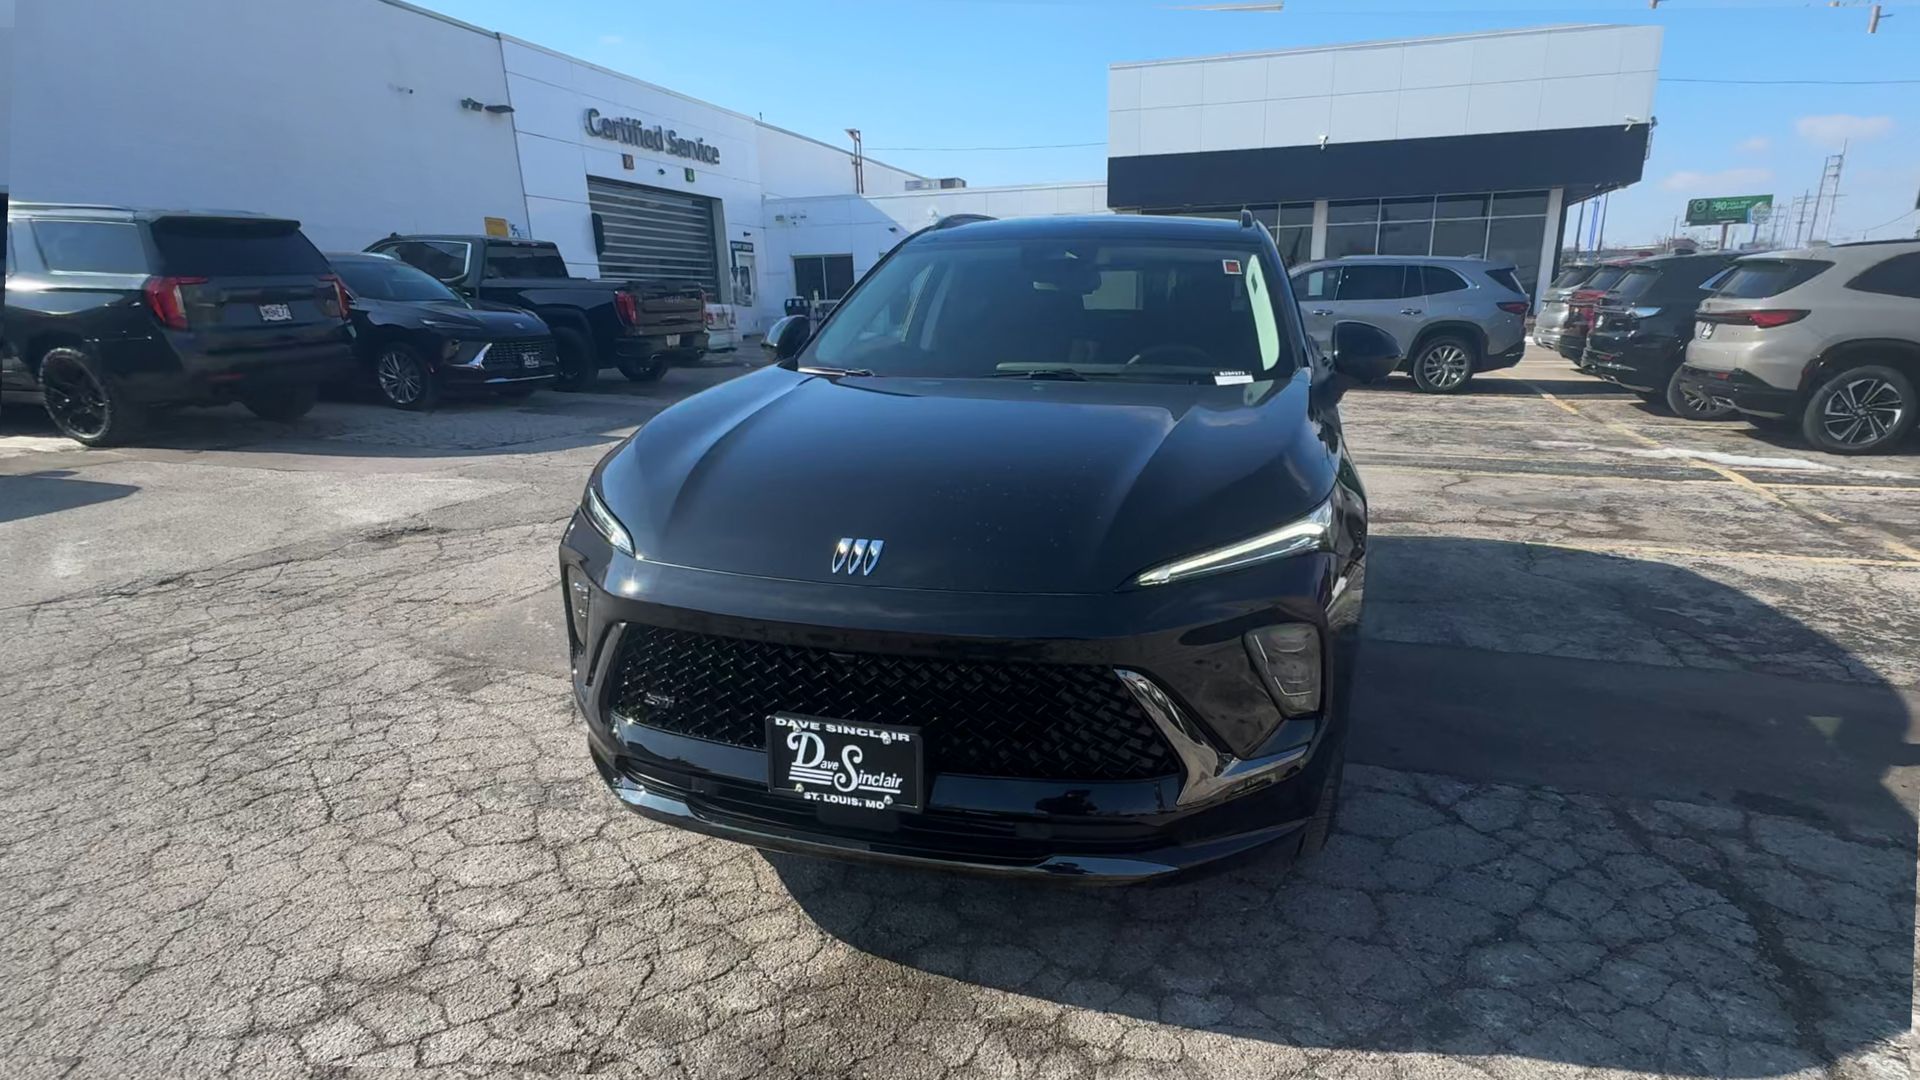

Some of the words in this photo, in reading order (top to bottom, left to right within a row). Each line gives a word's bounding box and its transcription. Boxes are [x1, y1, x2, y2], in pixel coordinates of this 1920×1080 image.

[584, 108, 664, 151] Certified
[665, 129, 720, 164] Service
[775, 717, 820, 730] DAVE
[826, 724, 911, 742] SINCLAIR
[787, 731, 839, 771] Dave
[834, 744, 903, 792] Sinclair
[804, 791, 820, 801] ST.
[865, 800, 885, 810] MO
